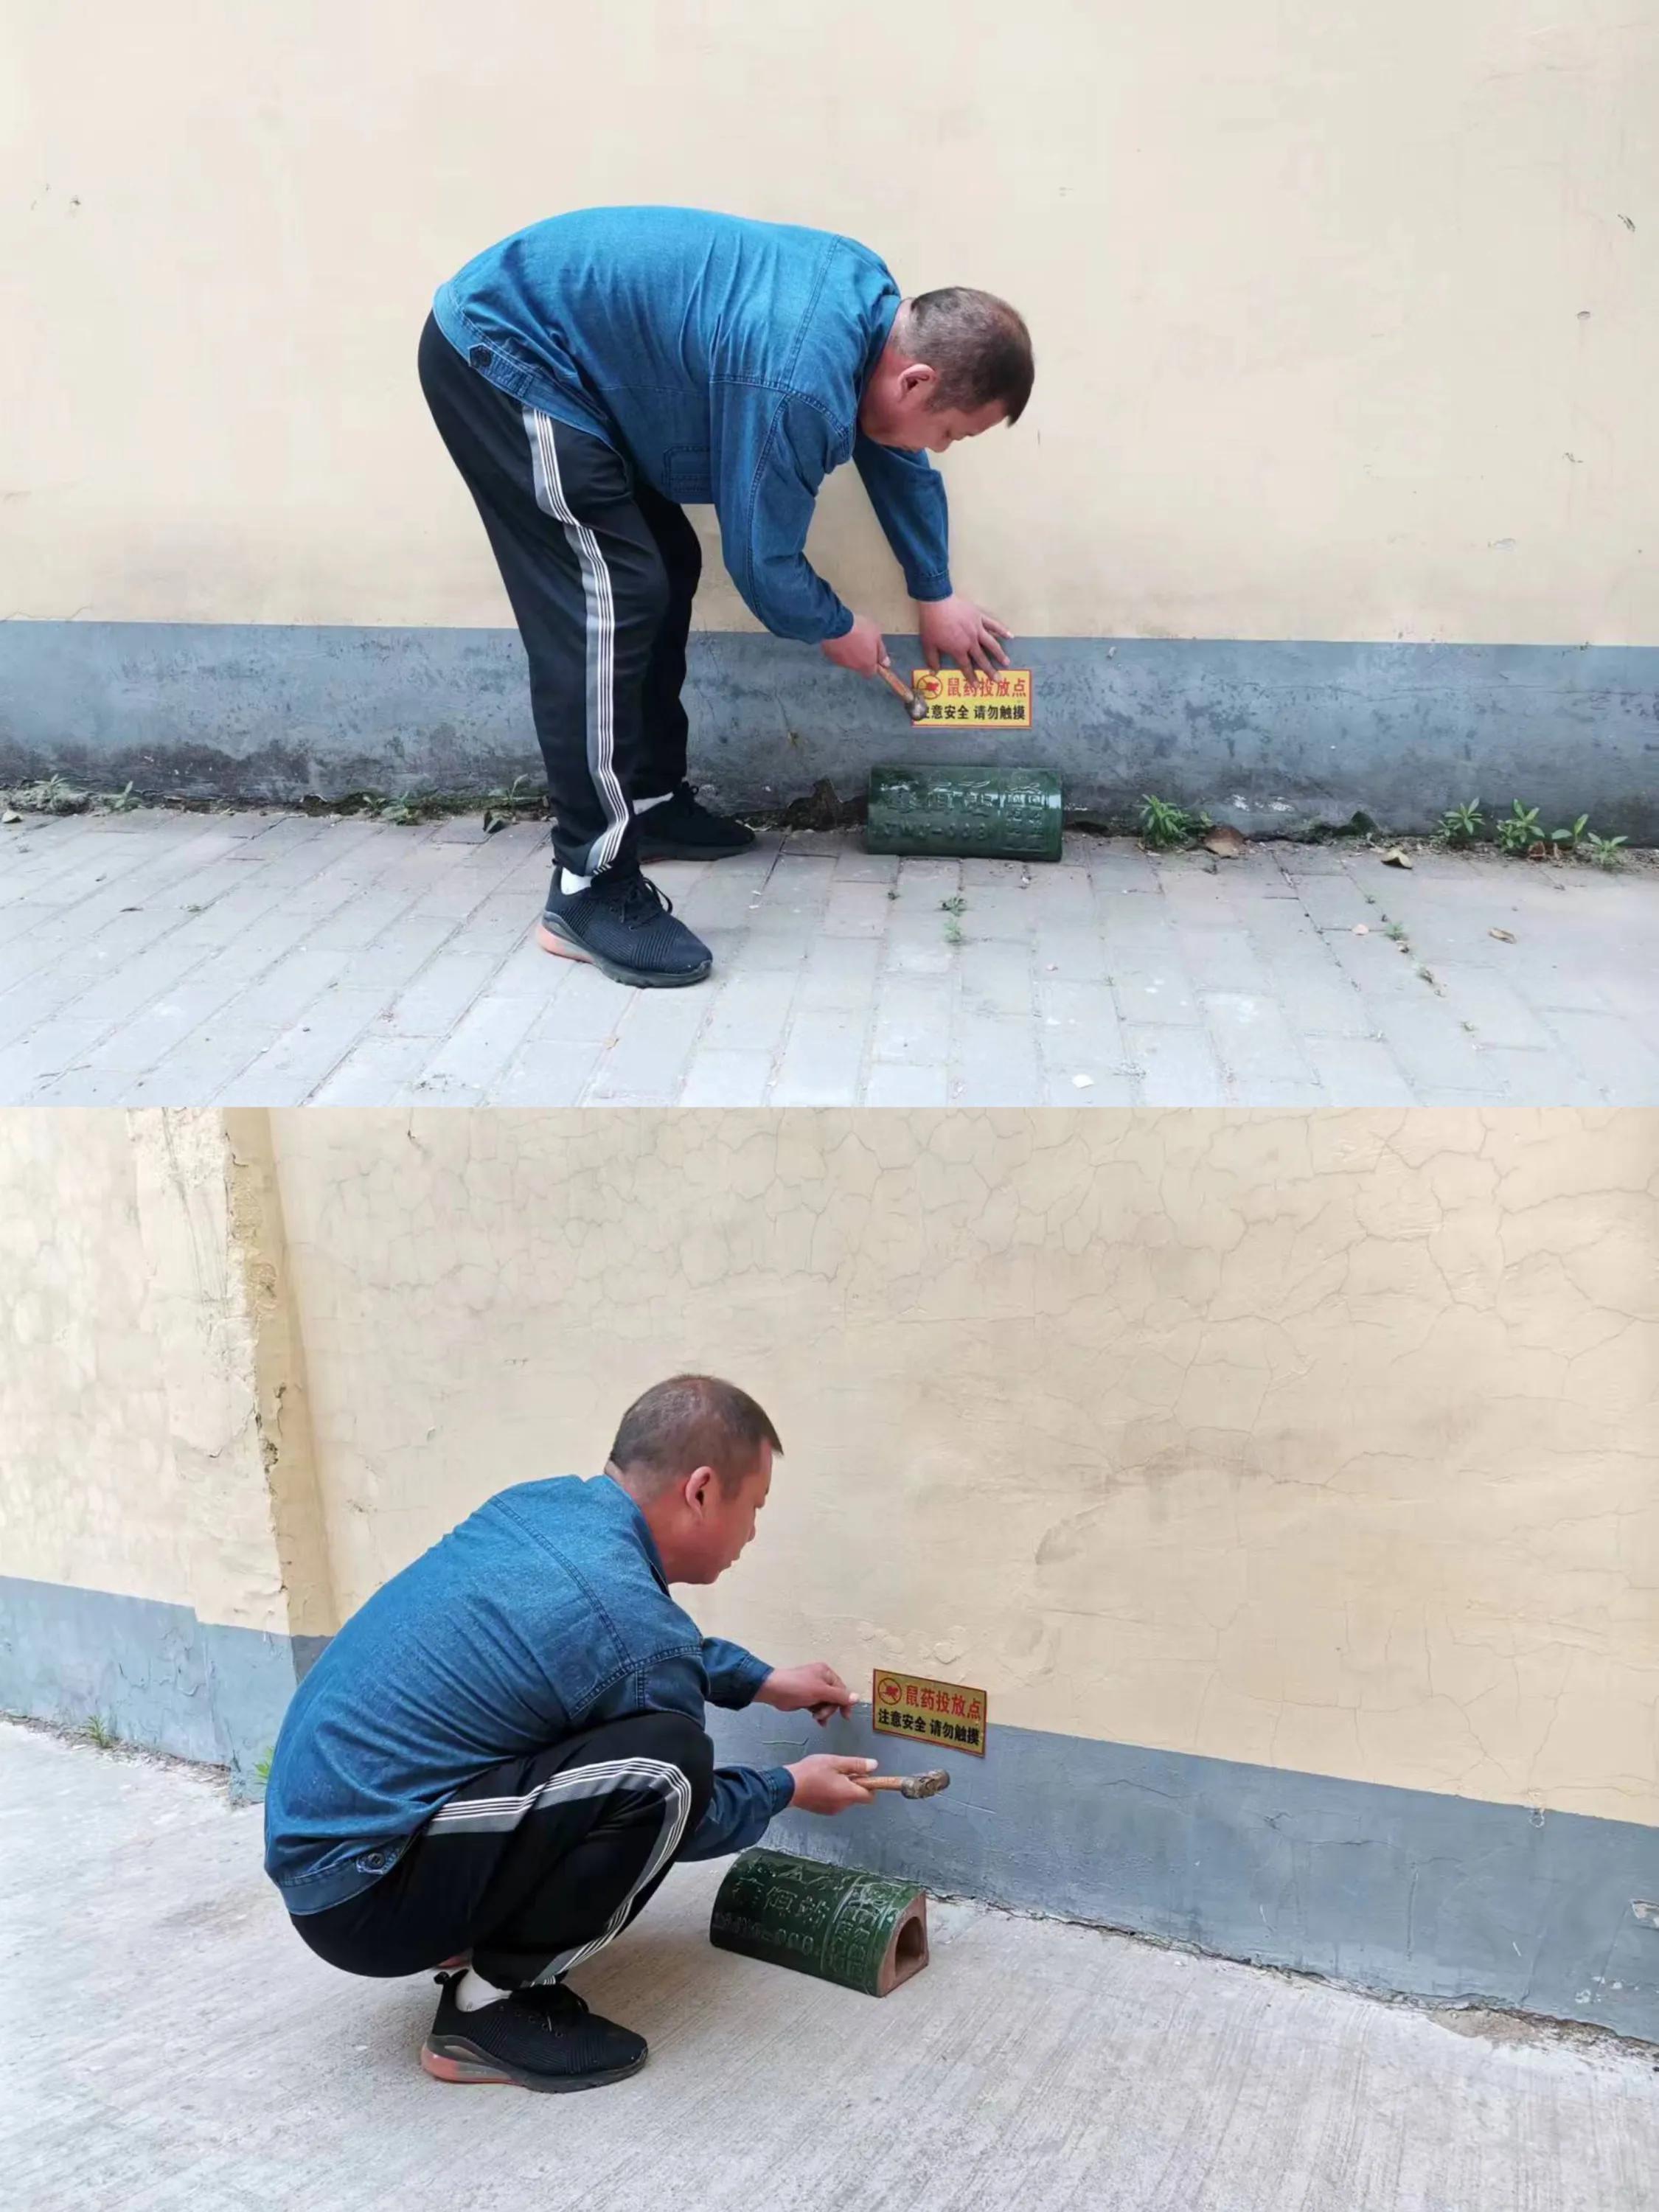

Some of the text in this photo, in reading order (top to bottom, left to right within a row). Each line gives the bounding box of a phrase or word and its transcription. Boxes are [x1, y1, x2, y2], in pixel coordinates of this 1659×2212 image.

[973, 705, 1026, 720] 请勿触摸
[905, 1684, 982, 1721] 鼠药投放点
[878, 1708, 980, 1747] 注意安全 请勿触摸
